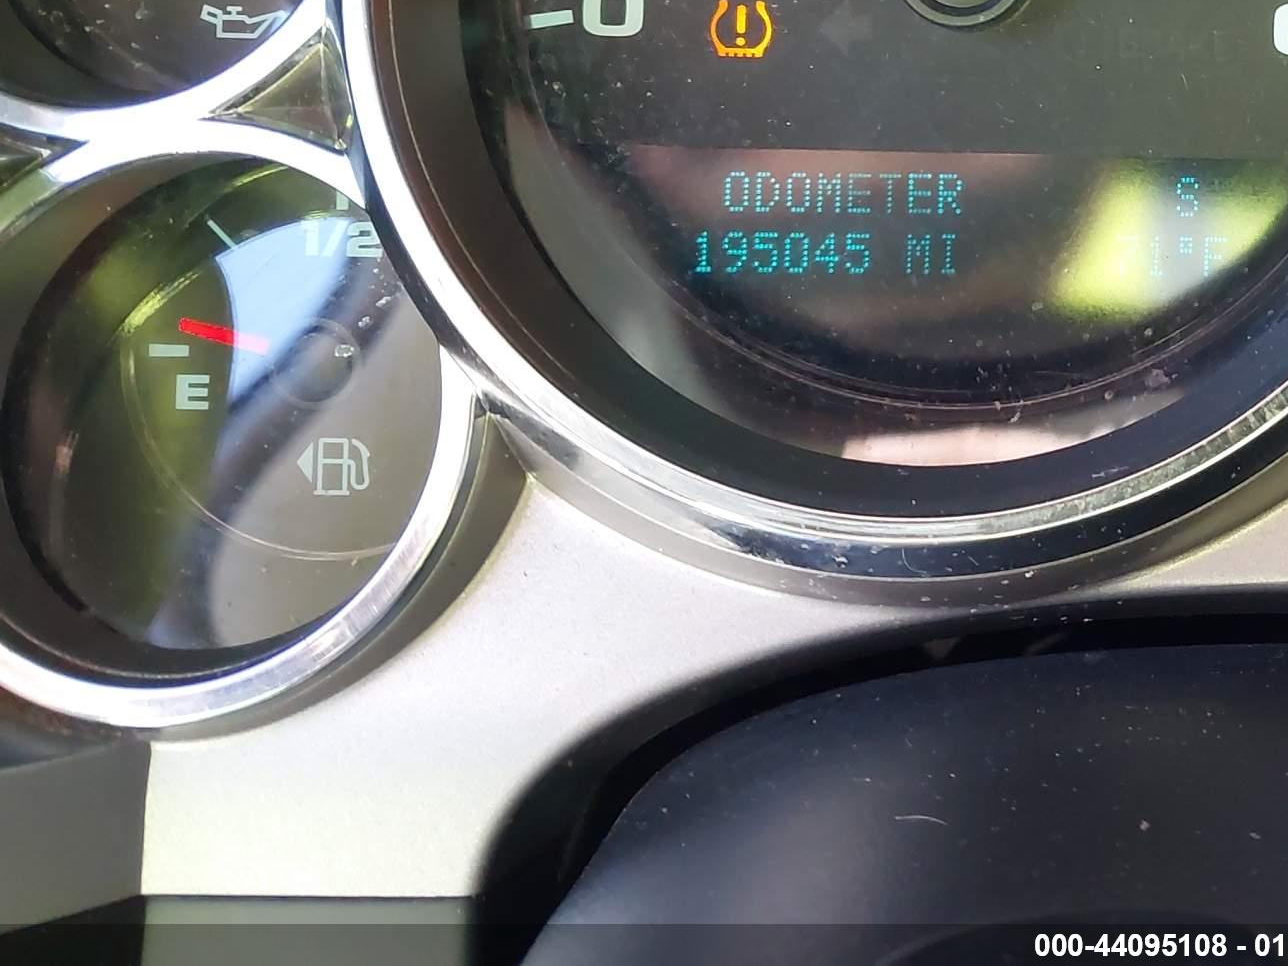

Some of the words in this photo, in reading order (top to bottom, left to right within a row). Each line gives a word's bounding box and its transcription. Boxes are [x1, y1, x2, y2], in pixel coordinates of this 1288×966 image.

[723, 171, 964, 214] ODOMETER
[301, 219, 384, 258] 1/2
[694, 231, 869, 274] 195045
[906, 233, 956, 274] MI
[175, 374, 210, 410] E
